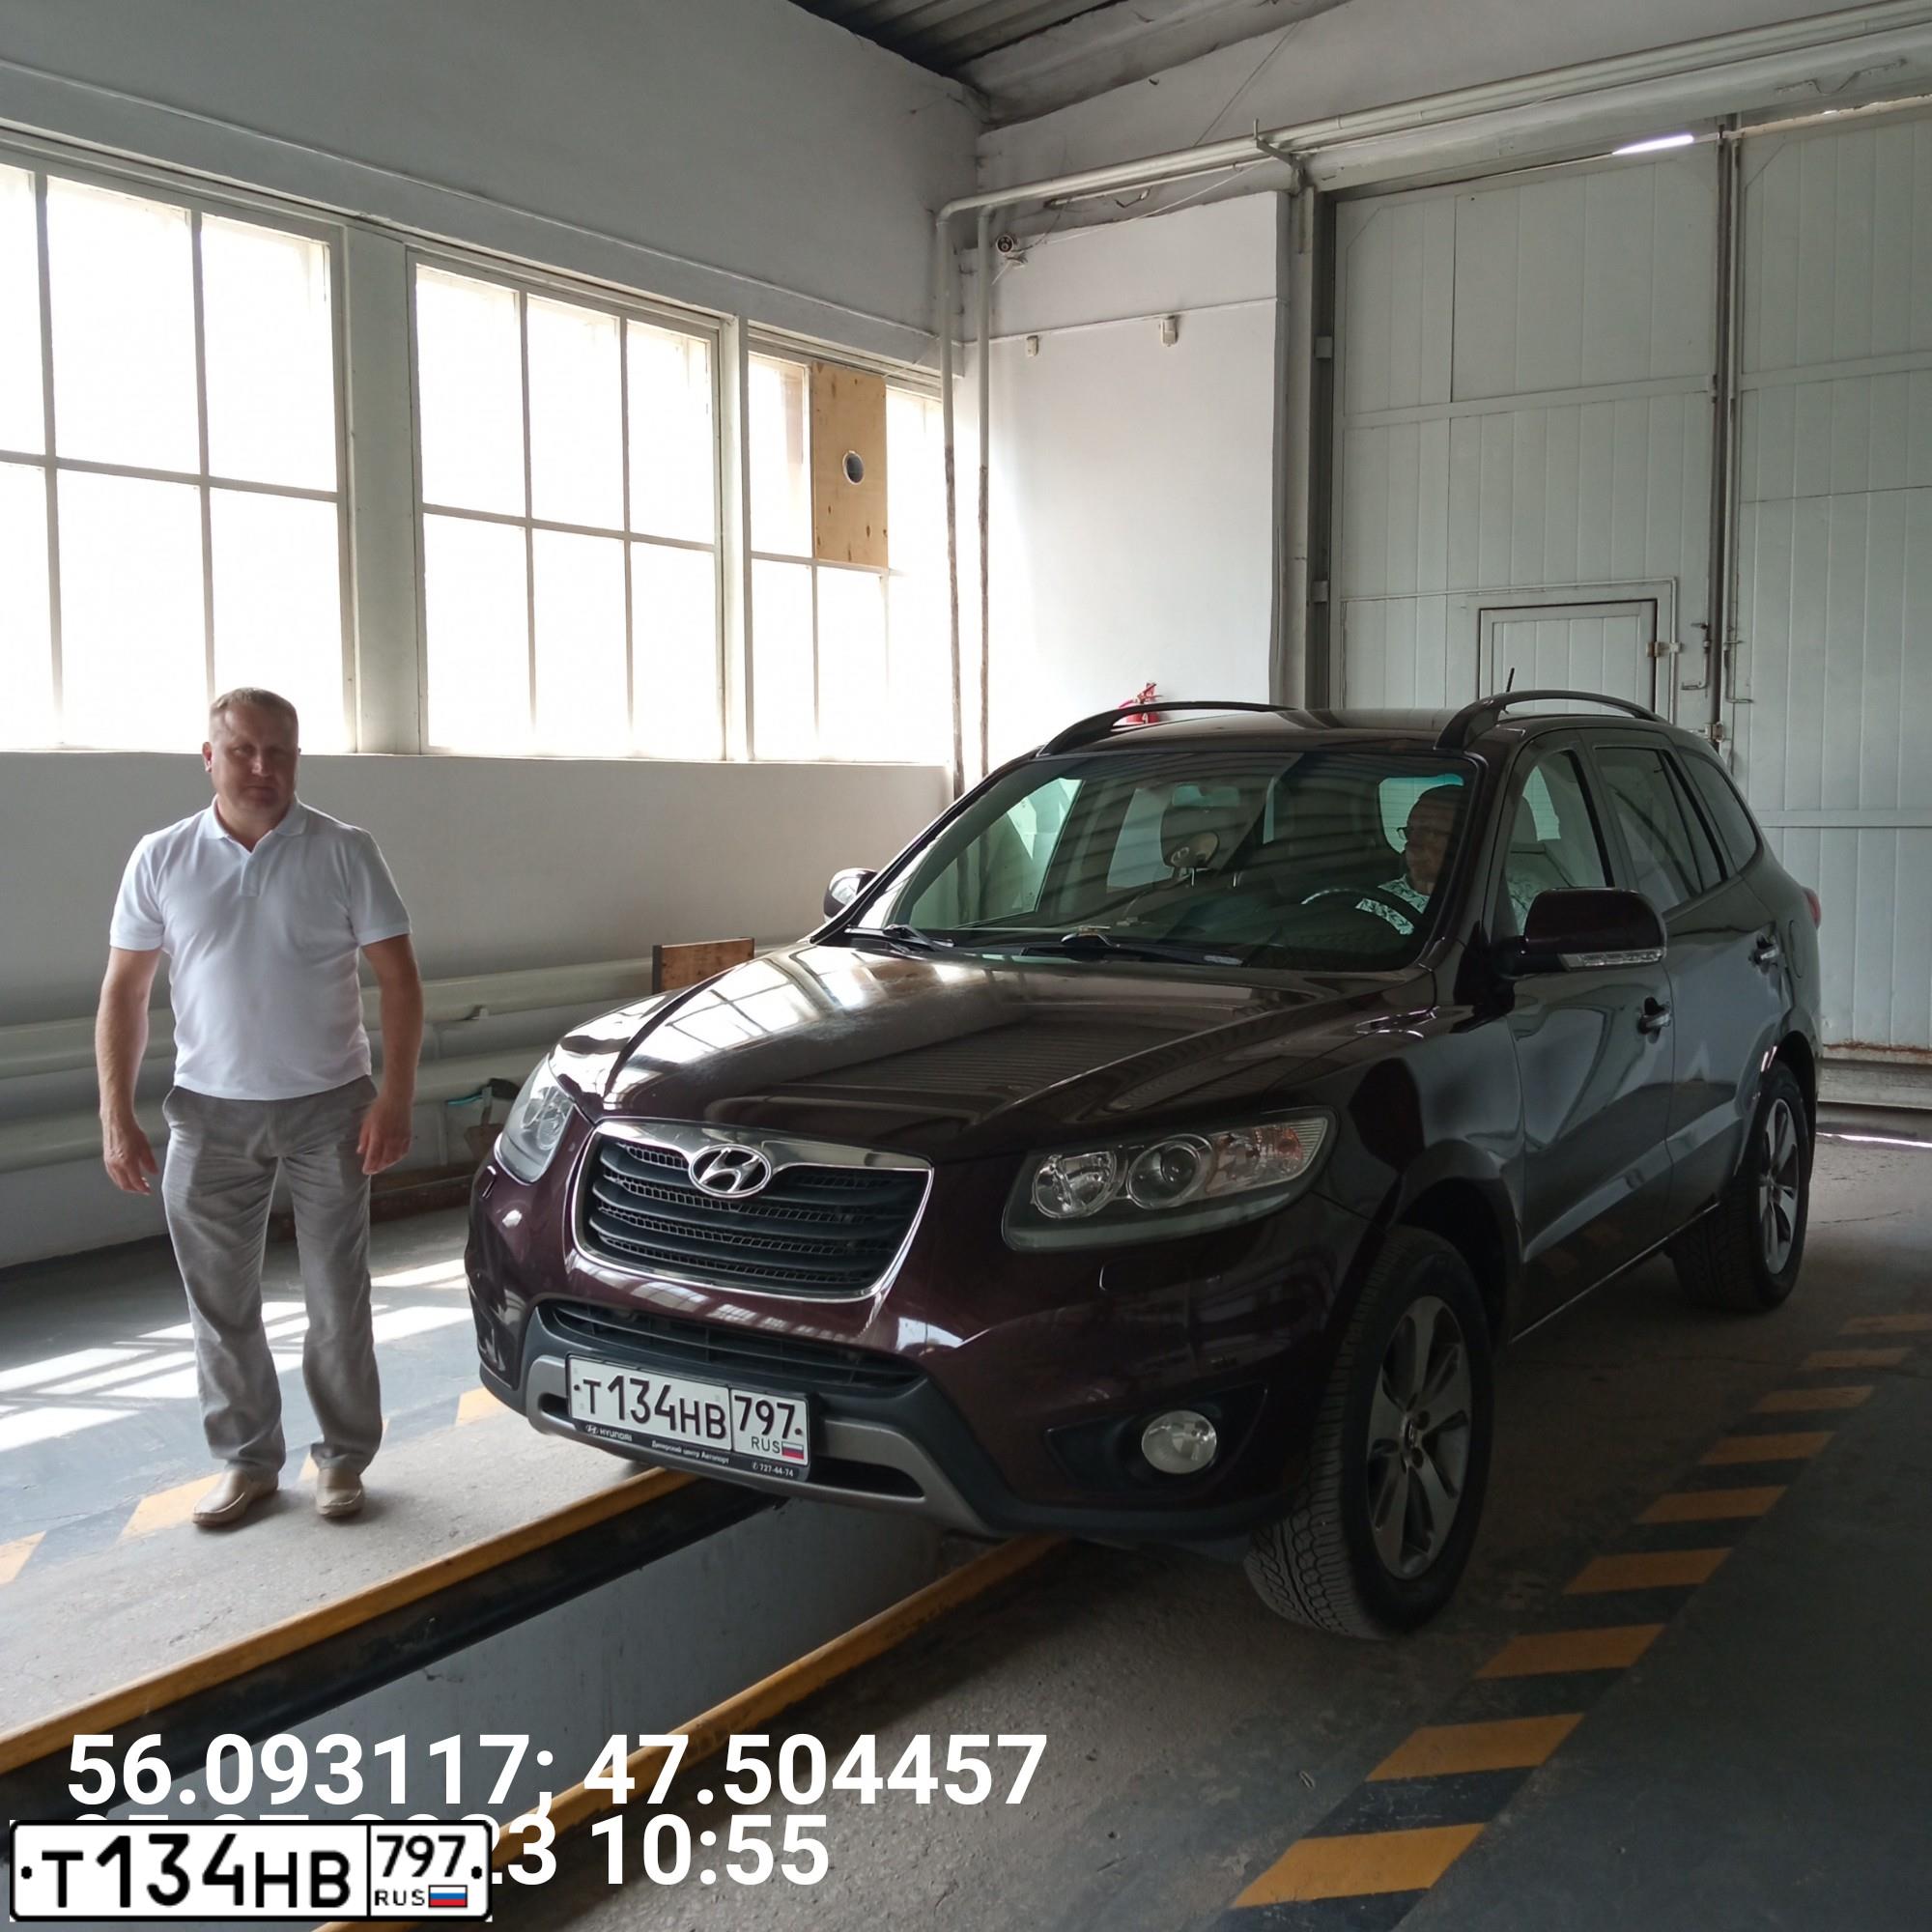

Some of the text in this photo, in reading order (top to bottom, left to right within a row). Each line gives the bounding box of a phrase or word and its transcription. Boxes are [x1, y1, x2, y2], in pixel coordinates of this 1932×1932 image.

[734, 1395, 795, 1439] 797
[599, 1428, 633, 1442] HYUNDAI
[751, 1436, 781, 1454] RUS
